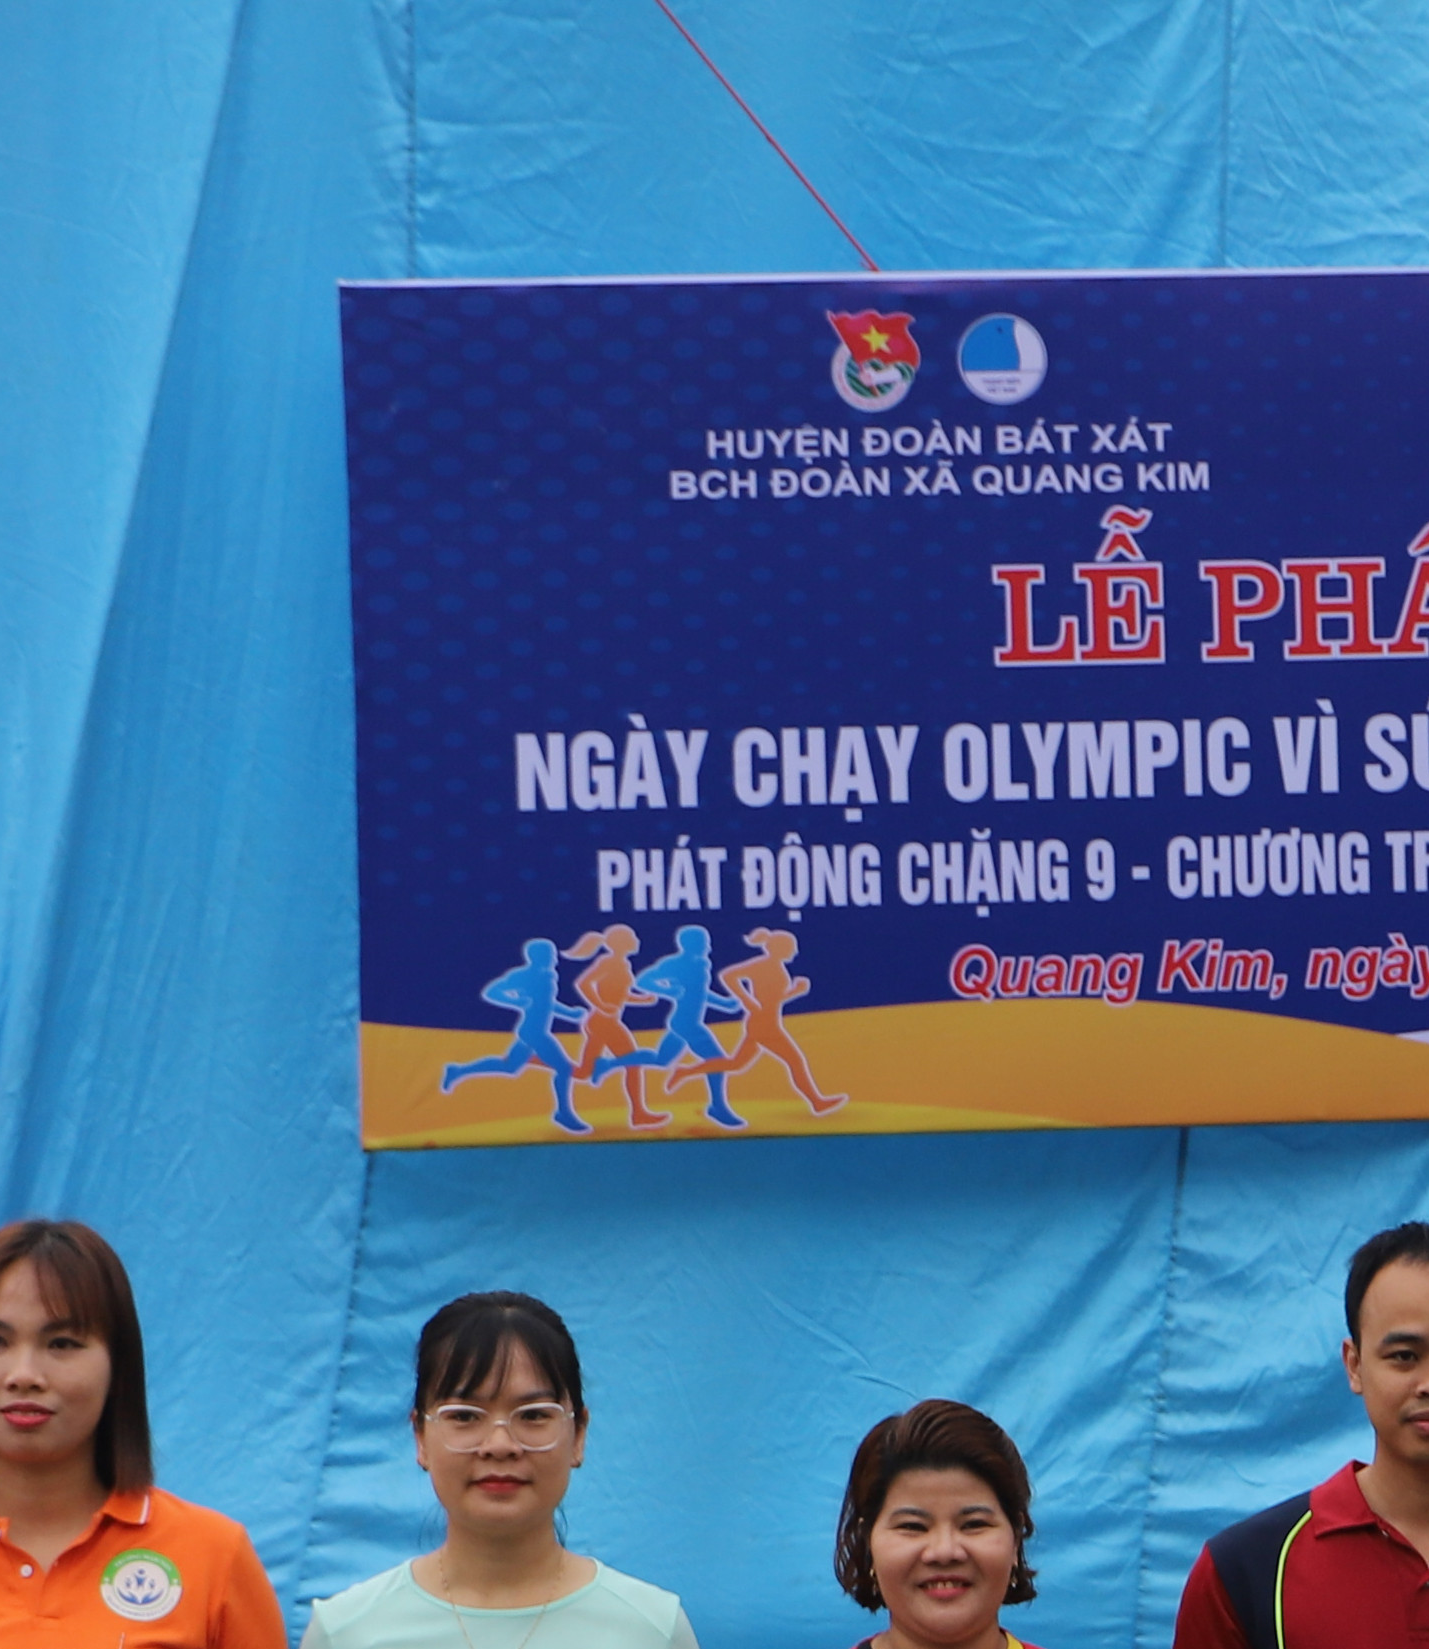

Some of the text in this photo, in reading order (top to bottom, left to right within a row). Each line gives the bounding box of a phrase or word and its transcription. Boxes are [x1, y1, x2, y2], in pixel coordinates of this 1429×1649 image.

[708, 417, 1172, 462] HUYỆN ĐOÀN BÁT XÁT
[671, 461, 1209, 499] BCH ĐOÀN XÃ QUANG KIM
[992, 505, 1165, 667] LỄ
[516, 714, 708, 810] NGÀY
[733, 726, 918, 821] CHẠY
[944, 717, 1250, 802] OLYMPIC
[1273, 699, 1338, 793] VÌ
[598, 835, 726, 909] PHÁT
[741, 831, 881, 921] ĐỘNG
[898, 828, 1069, 916] CHẶNG
[1086, 839, 1115, 900] 9
[1167, 828, 1370, 898] CHƯƠNG
[951, 946, 1141, 1003] Quang
[1157, 939, 1287, 998] Kim,
